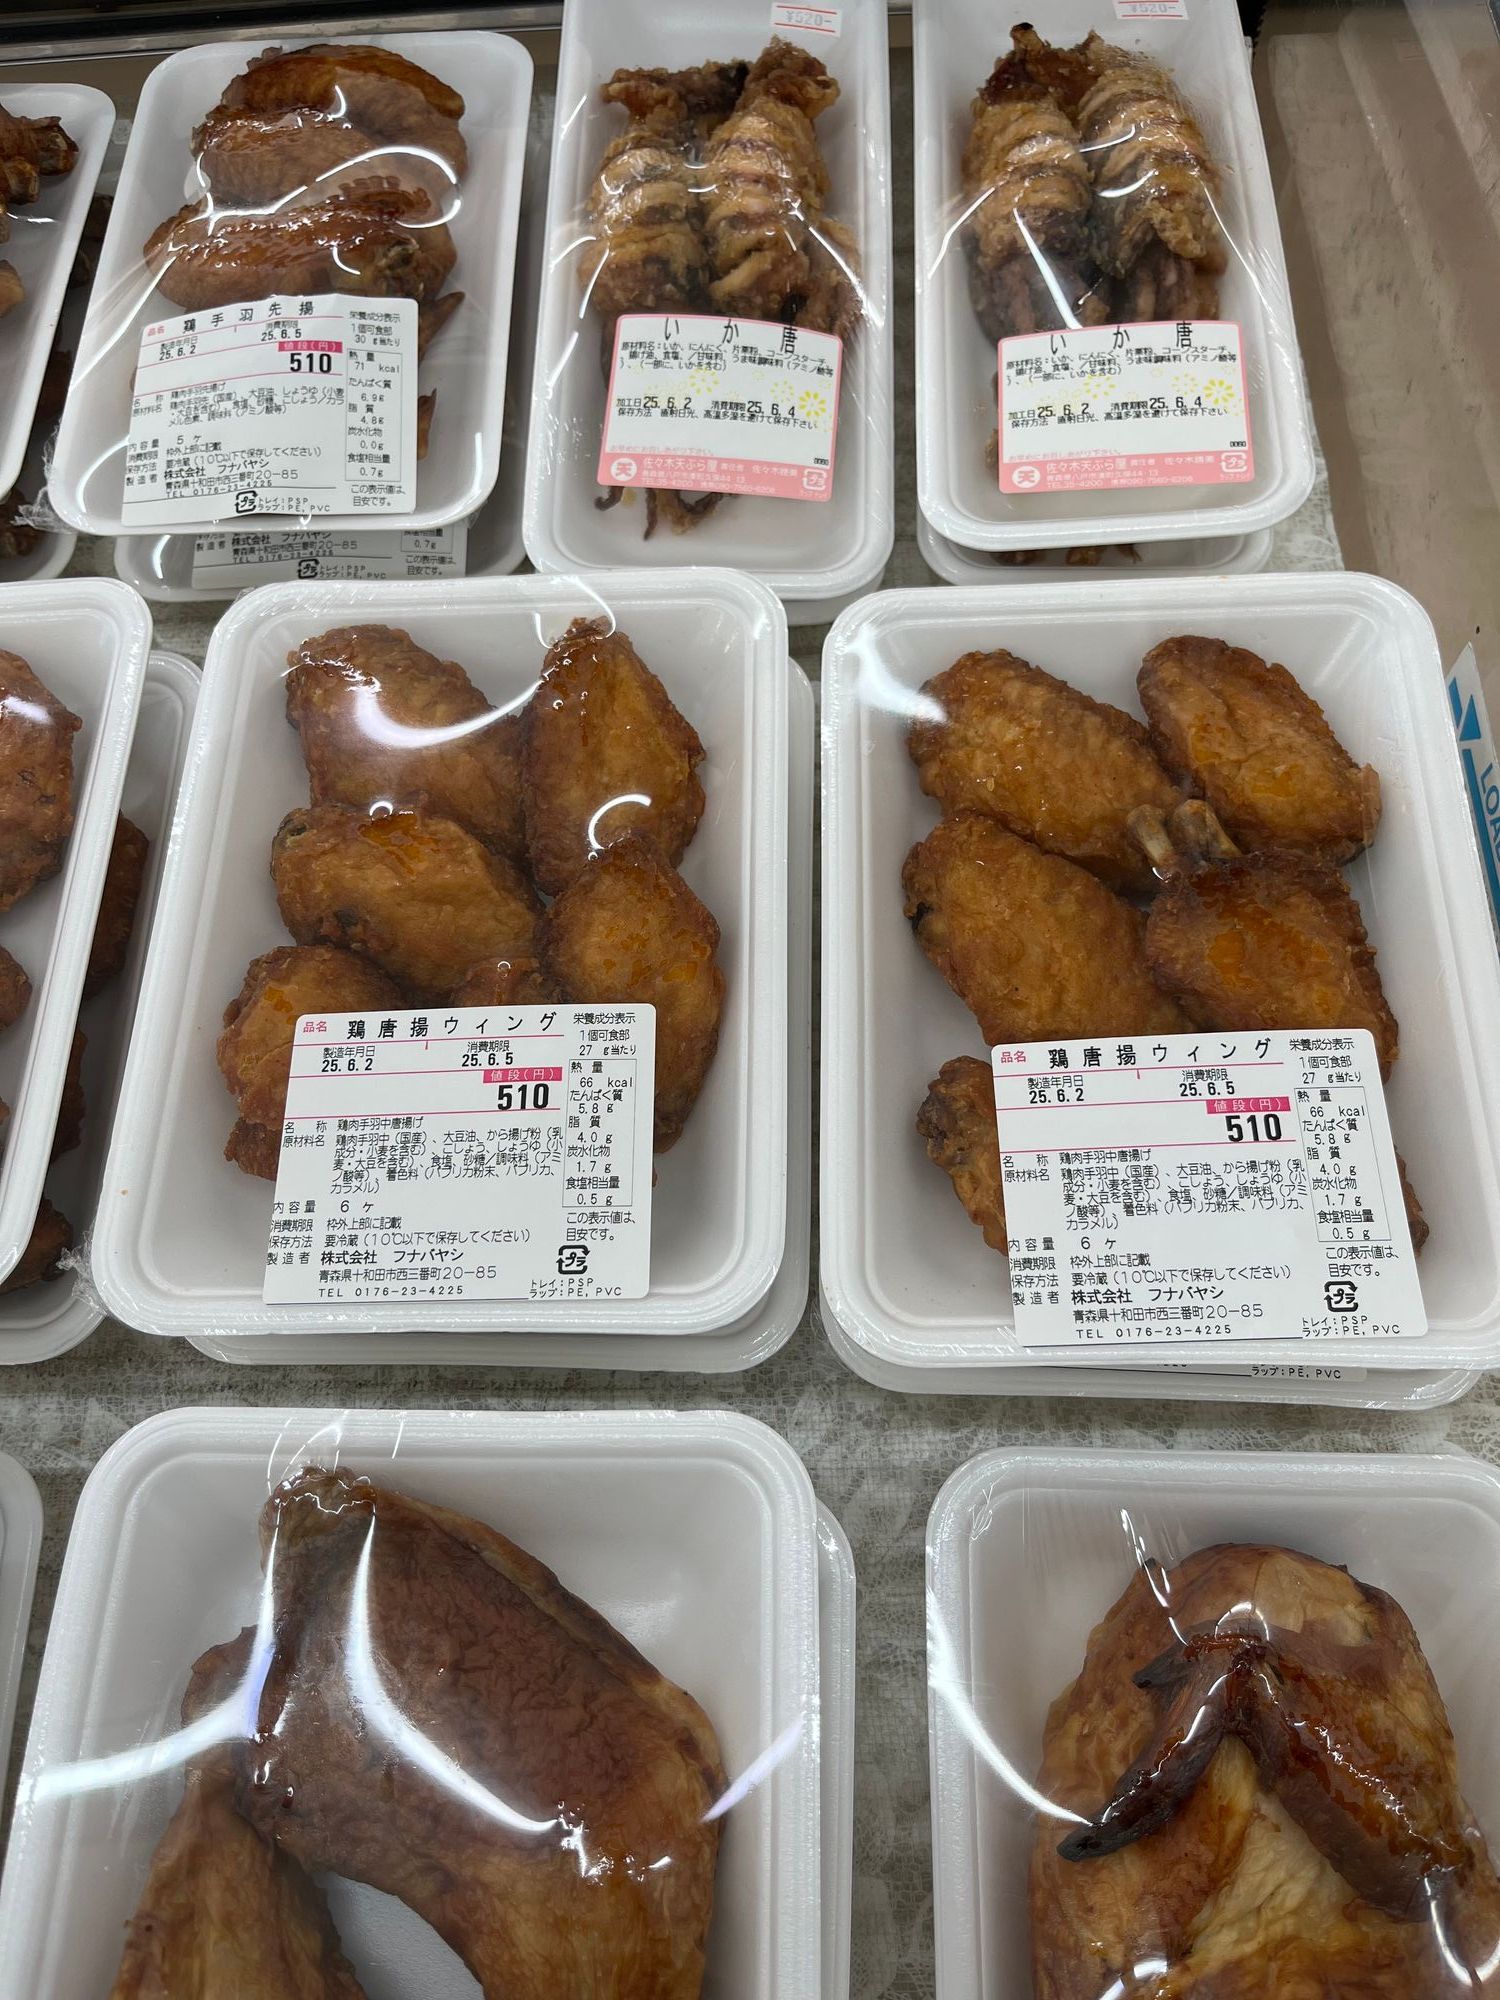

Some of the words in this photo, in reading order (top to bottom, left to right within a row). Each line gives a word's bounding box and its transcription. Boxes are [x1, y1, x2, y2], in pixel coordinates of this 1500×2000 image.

[147, 326, 164, 336] 品名
[183, 301, 314, 333] 鶏手羽先揚
[350, 311, 400, 323] 栄養成分表示
[261, 329, 301, 342] 25.6.5
[352, 324, 393, 336] 1個可食部
[665, 316, 798, 353] いか唐
[354, 335, 366, 344] 30
[1051, 321, 1192, 354] いか唐
[159, 345, 196, 361] 25.6.2
[290, 353, 332, 373] 510
[355, 362, 364, 371] 71
[379, 364, 400, 373] kcal
[349, 378, 391, 389] たんぱく質
[618, 408, 652, 417] 保存方法
[1011, 418, 1048, 429] 保存方法
[348, 427, 383, 437] 炭水化物
[129, 438, 159, 452] 内容量
[348, 454, 391, 464] 食塩相当量
[126, 462, 157, 473] 保存方法
[126, 474, 158, 486] 製造者
[164, 467, 205, 480] 株式会社
[219, 460, 270, 474] フナバヤシ
[166, 490, 184, 499] TEL
[310, 504, 330, 512] PVC
[353, 497, 392, 507] 目安です。
[232, 535, 271, 546] 株式会社
[573, 1012, 636, 1025] 栄養成分表示
[303, 1021, 327, 1033] 品名
[347, 1012, 557, 1039] 鶏唐揚ウィング
[580, 1029, 630, 1041] 1個可食部
[467, 1040, 510, 1053] 消費期限
[580, 1045, 591, 1055] 27
[1289, 1038, 1355, 1051] 栄養成分表示
[323, 1045, 375, 1059] 製造年月日
[1000, 1050, 1026, 1063] 品名
[1048, 1037, 1271, 1069] 鶏唐揚ウィング
[321, 1058, 373, 1072] 25.6.2
[462, 1052, 514, 1067] 25.6.5
[1299, 1055, 1351, 1068] 1個可食部
[571, 1061, 603, 1073] 熱量
[490, 1068, 554, 1081] 値段（円）
[1182, 1068, 1228, 1081] 消費期限
[1302, 1072, 1315, 1084] 27
[580, 1077, 593, 1088] 66
[607, 1077, 633, 1088] kcal
[1027, 1075, 1083, 1090] 製造年月日
[497, 1083, 549, 1110] 510
[570, 1089, 623, 1102] たんぱく質
[1029, 1088, 1084, 1104] 25.6.2
[1179, 1081, 1235, 1100] 25.6.5
[1297, 1090, 1332, 1103] 熱量
[1214, 1098, 1281, 1111] 値段（円）
[1310, 1107, 1324, 1117] 66
[1339, 1106, 1366, 1117] kcal
[337, 1116, 424, 1132] 鶏肉手羽中唐揚げ
[568, 1115, 601, 1128] 脂質
[1226, 1113, 1282, 1142] 510
[1302, 1118, 1359, 1132] たんぱく質
[282, 1135, 325, 1148] 原材料名
[567, 1144, 611, 1157] 炭水化物
[1059, 1149, 1151, 1165] 鶏肉手羽中唐揚げ
[1307, 1147, 1342, 1160] 脂質
[1004, 1168, 1049, 1182] 原材料名
[330, 1182, 380, 1195] カラメル）
[566, 1176, 620, 1190] 食塩相当量
[1312, 1176, 1357, 1190] 炭水化物
[273, 1200, 316, 1214] 内容量
[567, 1211, 636, 1224] この表示値は、
[1317, 1209, 1374, 1224] 食塩相当量
[271, 1219, 314, 1233] 消費期限
[327, 1217, 402, 1231] 枠外上部に記載
[1066, 1218, 1119, 1231] カラメル）
[567, 1228, 615, 1241] 目安です。
[269, 1235, 312, 1248] 保存方法
[1008, 1236, 1055, 1252] 内容量
[267, 1252, 310, 1266] 製造者
[320, 1249, 377, 1266] 株式会社
[394, 1248, 464, 1263] フナバヤシ
[1326, 1245, 1399, 1260] この表示値は、
[565, 1252, 587, 1268] プラ
[1010, 1257, 1056, 1271] 消費期限
[1070, 1253, 1151, 1268] 枠外上部に記載
[1329, 1263, 1381, 1278] 目安です。
[1011, 1274, 1059, 1288] 保存方法
[318, 1288, 343, 1298] TEL
[355, 1285, 463, 1297] 0176-23-4225
[595, 1287, 622, 1296] PVC
[1013, 1290, 1060, 1306] 製造者
[1071, 1288, 1132, 1305] 株式会社
[1149, 1286, 1224, 1302] フナバヤシ
[1333, 1288, 1355, 1305] プラ
[1076, 1329, 1103, 1338] TEL
[1116, 1325, 1231, 1337] 0176-23-4225
[1372, 1324, 1400, 1334] PVC
[1315, 1369, 1341, 1379] PVC
